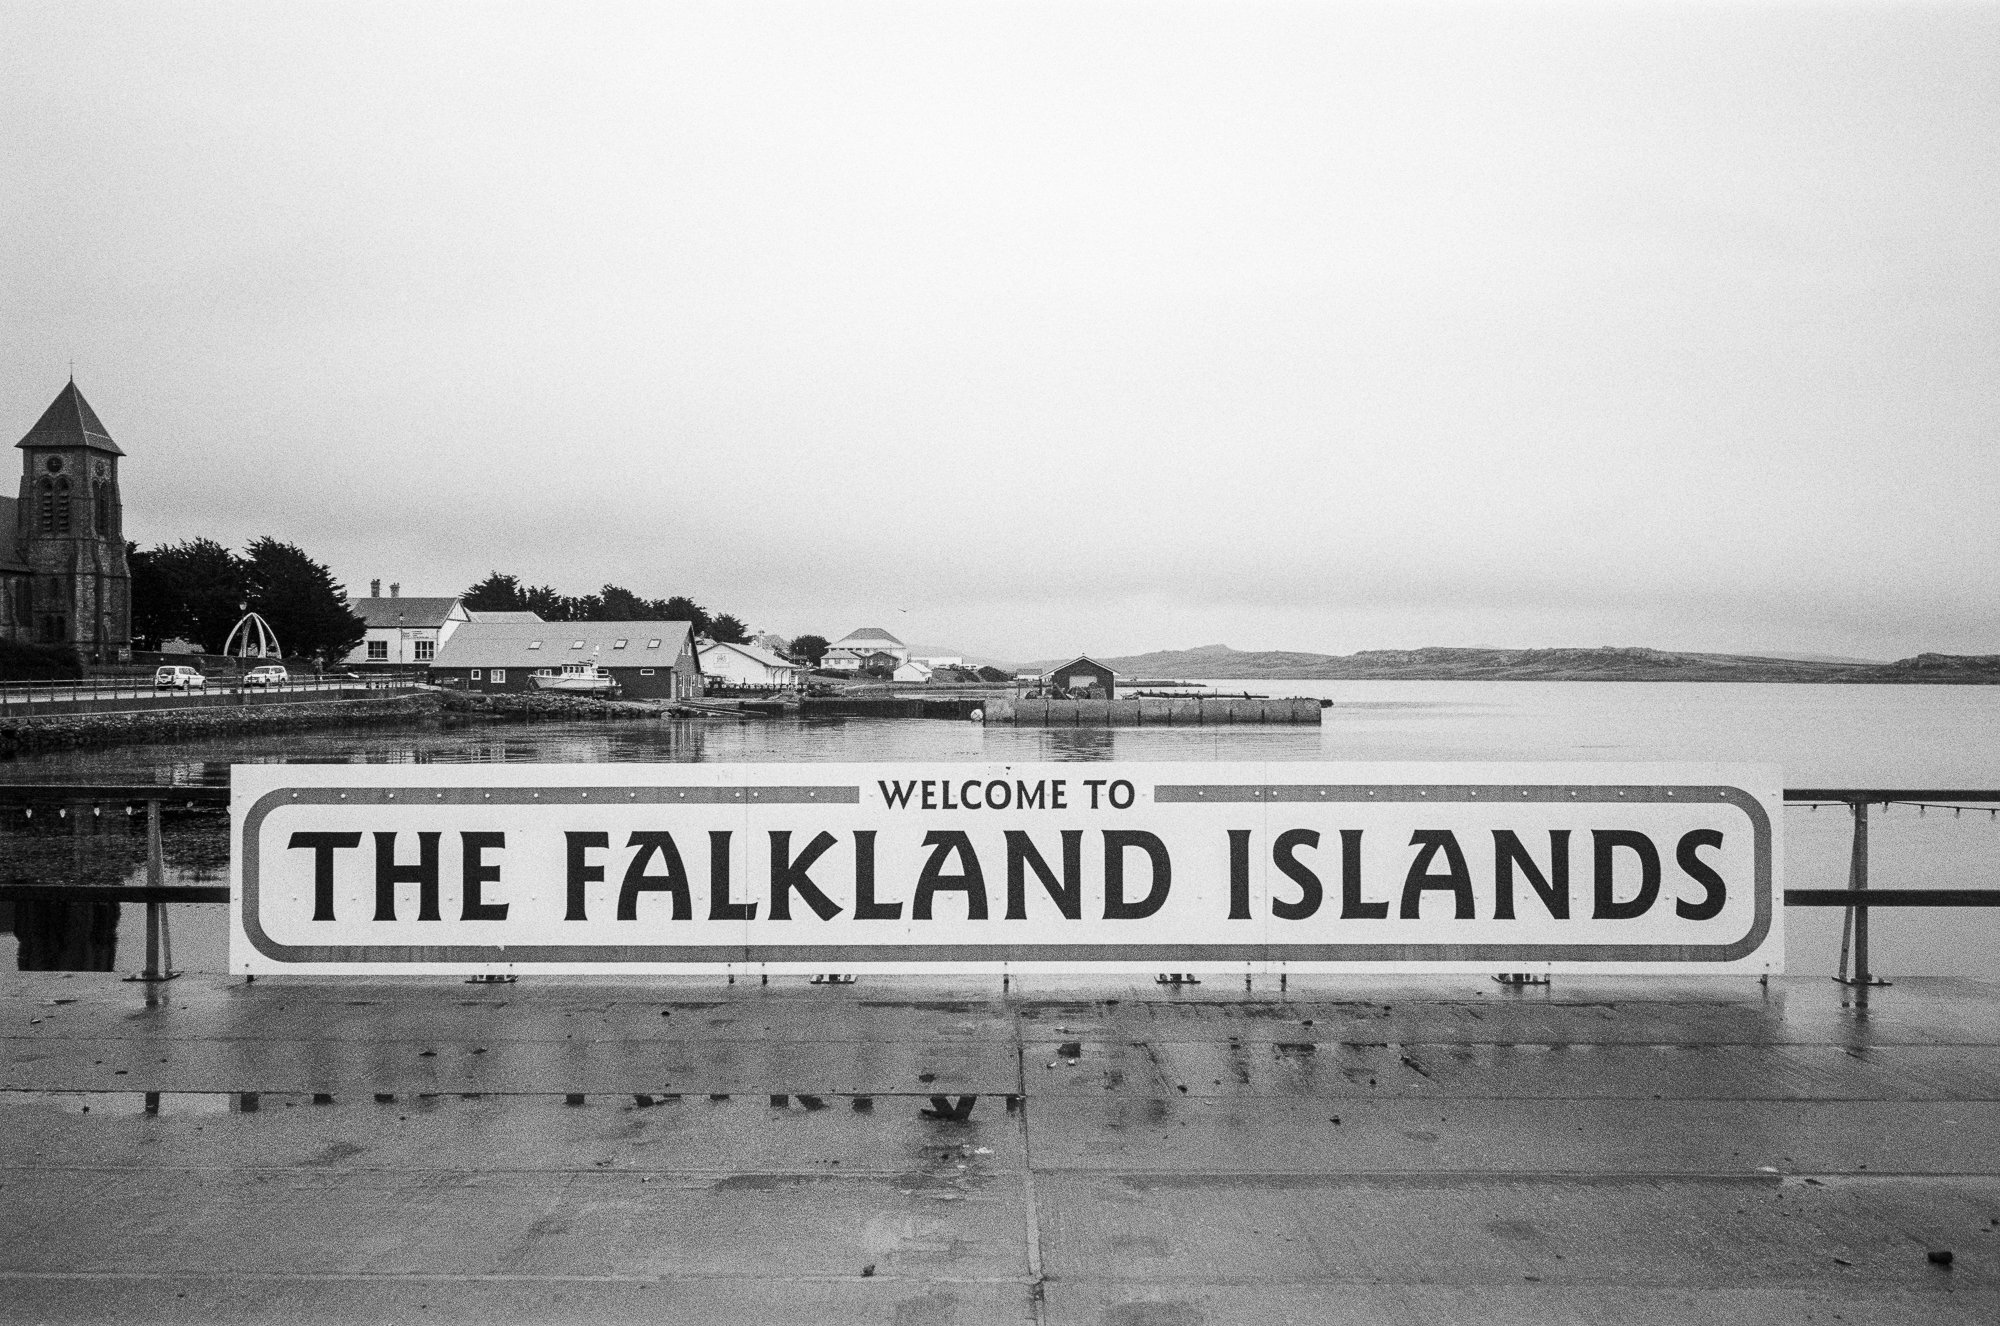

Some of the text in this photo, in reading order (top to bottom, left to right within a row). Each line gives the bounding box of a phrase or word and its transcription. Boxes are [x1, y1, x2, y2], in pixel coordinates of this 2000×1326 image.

[878, 779, 1134, 810] WELCOME TO
[287, 828, 1727, 922] THE FALKLAND ISLANDS
